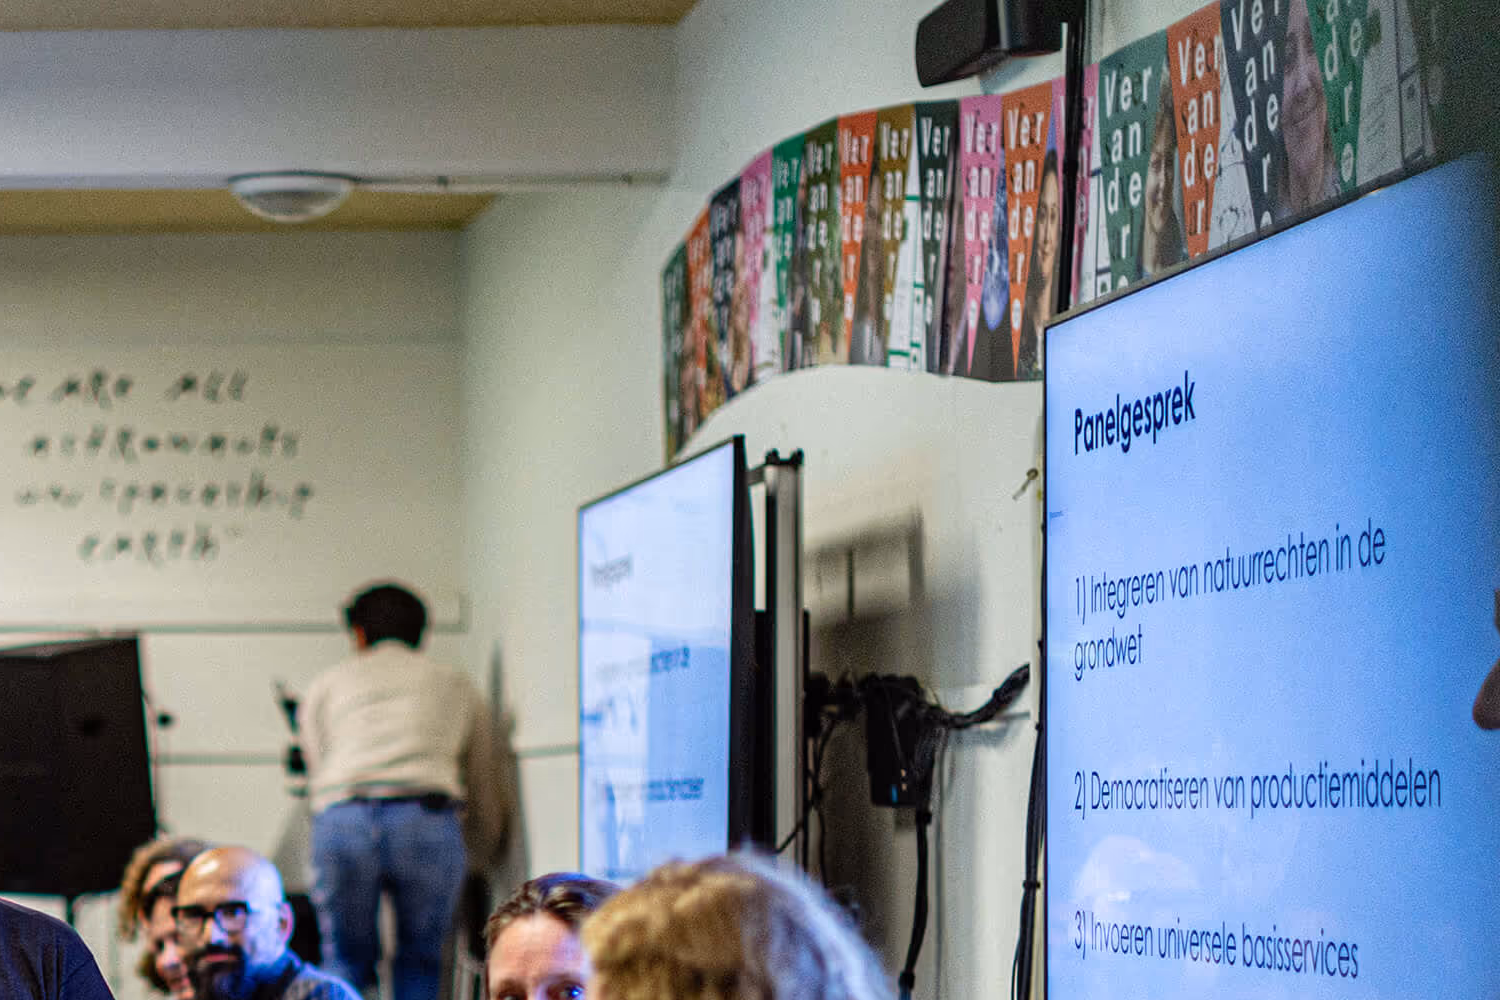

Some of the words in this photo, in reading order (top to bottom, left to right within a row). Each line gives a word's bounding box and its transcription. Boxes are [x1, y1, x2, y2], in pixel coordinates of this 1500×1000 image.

[1104, 66, 1152, 118] Ver
[1245, 38, 1276, 97] an
[1007, 108, 1045, 150] Ver
[1187, 89, 1214, 136] an
[1244, 93, 1279, 153] de
[1111, 120, 1142, 164] an
[1184, 139, 1215, 188] de
[1013, 160, 1036, 194] an
[1107, 167, 1143, 215] de
[1074, 370, 1196, 456] Panelgesprek
[1075, 575, 1086, 625] 1)
[1090, 570, 1165, 620] Integreren
[1169, 564, 1199, 598] van
[1203, 531, 1329, 594] natuurrechten
[1335, 522, 1351, 572] in
[1358, 517, 1386, 567] de
[1074, 623, 1143, 682] grondwet
[1074, 769, 1086, 820] 2)
[1090, 767, 1209, 810] Democratiseren
[1213, 771, 1245, 810] van
[1250, 757, 1442, 819] productiemiddelen
[1074, 909, 1086, 960] 3)
[1090, 911, 1154, 957] Invoeren
[1157, 917, 1237, 966] universele
[1241, 922, 1359, 979] basisservices
